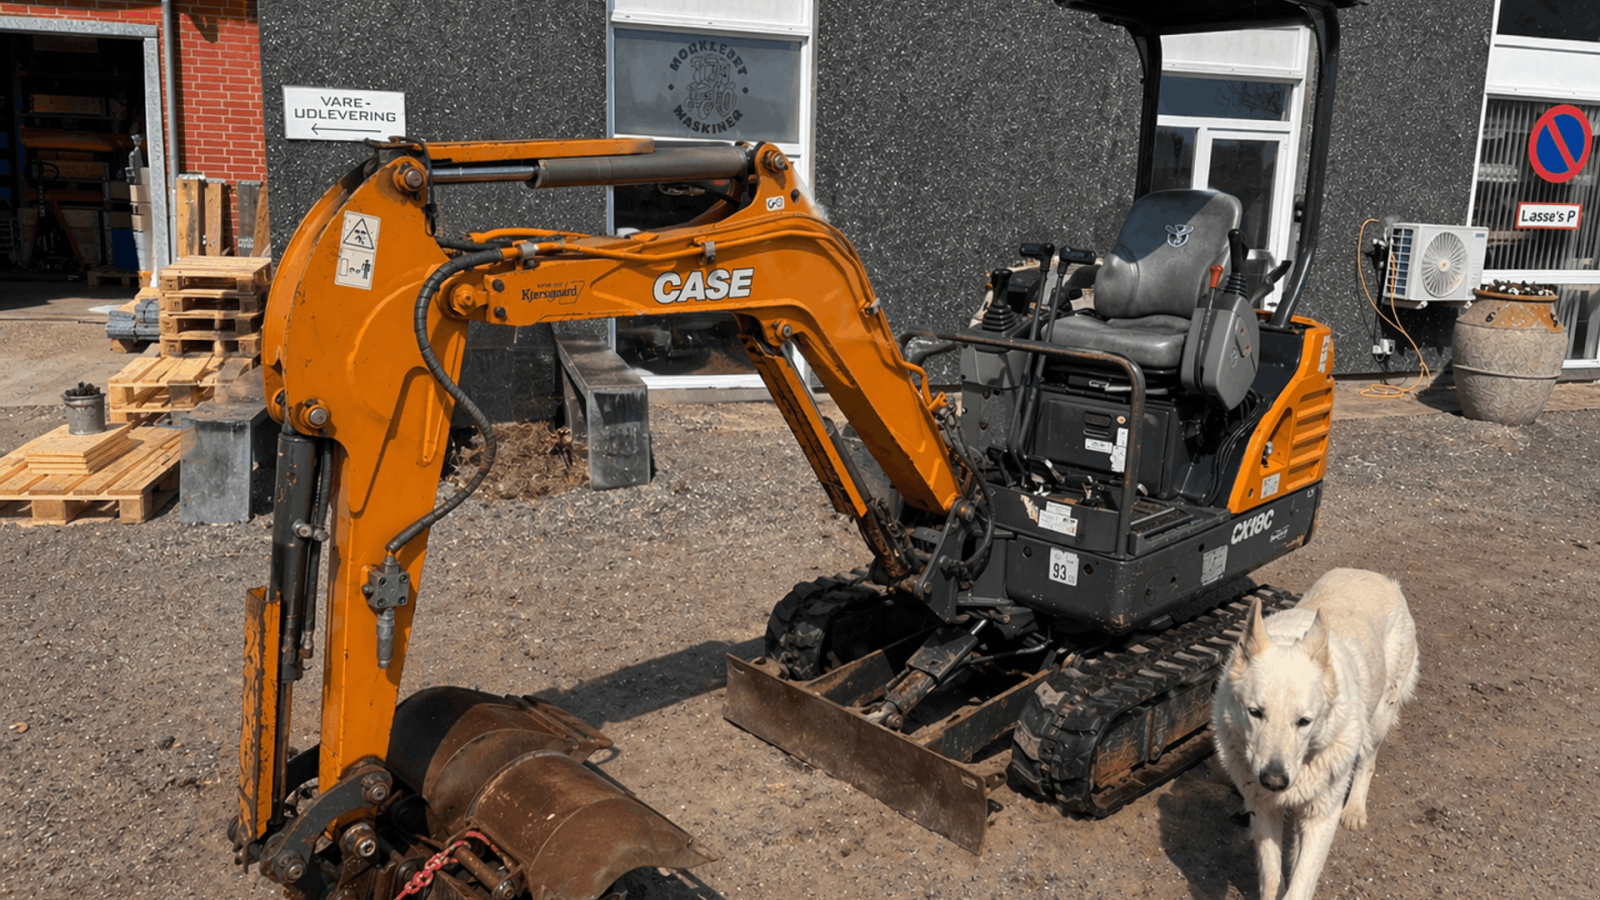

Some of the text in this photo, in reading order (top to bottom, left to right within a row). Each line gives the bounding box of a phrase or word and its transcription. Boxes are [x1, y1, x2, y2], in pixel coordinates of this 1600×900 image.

[320, 96, 371, 108] VARE-
[294, 108, 397, 123] UDLEVERING
[673, 104, 744, 135] MASKINER
[1521, 209, 1576, 223] Lasse's P
[652, 267, 755, 305] CASE
[1231, 509, 1275, 545] CX18C
[1052, 562, 1067, 581] 93
